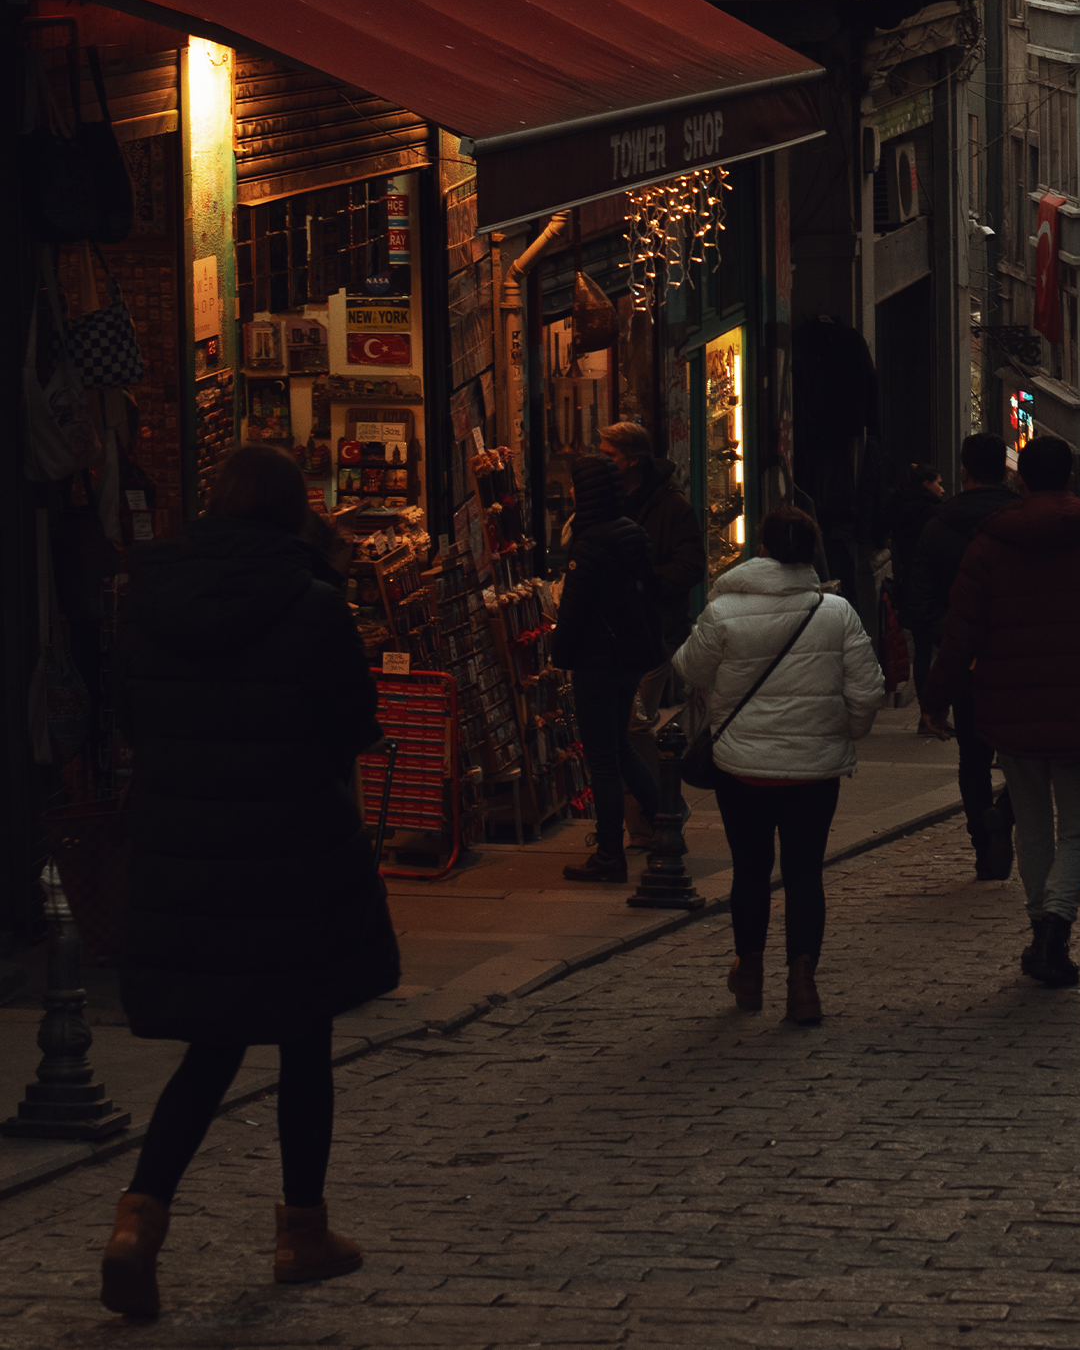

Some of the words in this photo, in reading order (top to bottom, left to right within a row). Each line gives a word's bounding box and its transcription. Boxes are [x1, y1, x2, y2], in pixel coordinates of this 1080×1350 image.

[611, 124, 666, 181] TOWER
[683, 110, 724, 162] SHOP
[388, 235, 406, 246] RAY
[348, 310, 372, 324] NEW
[378, 310, 409, 324] YORK
